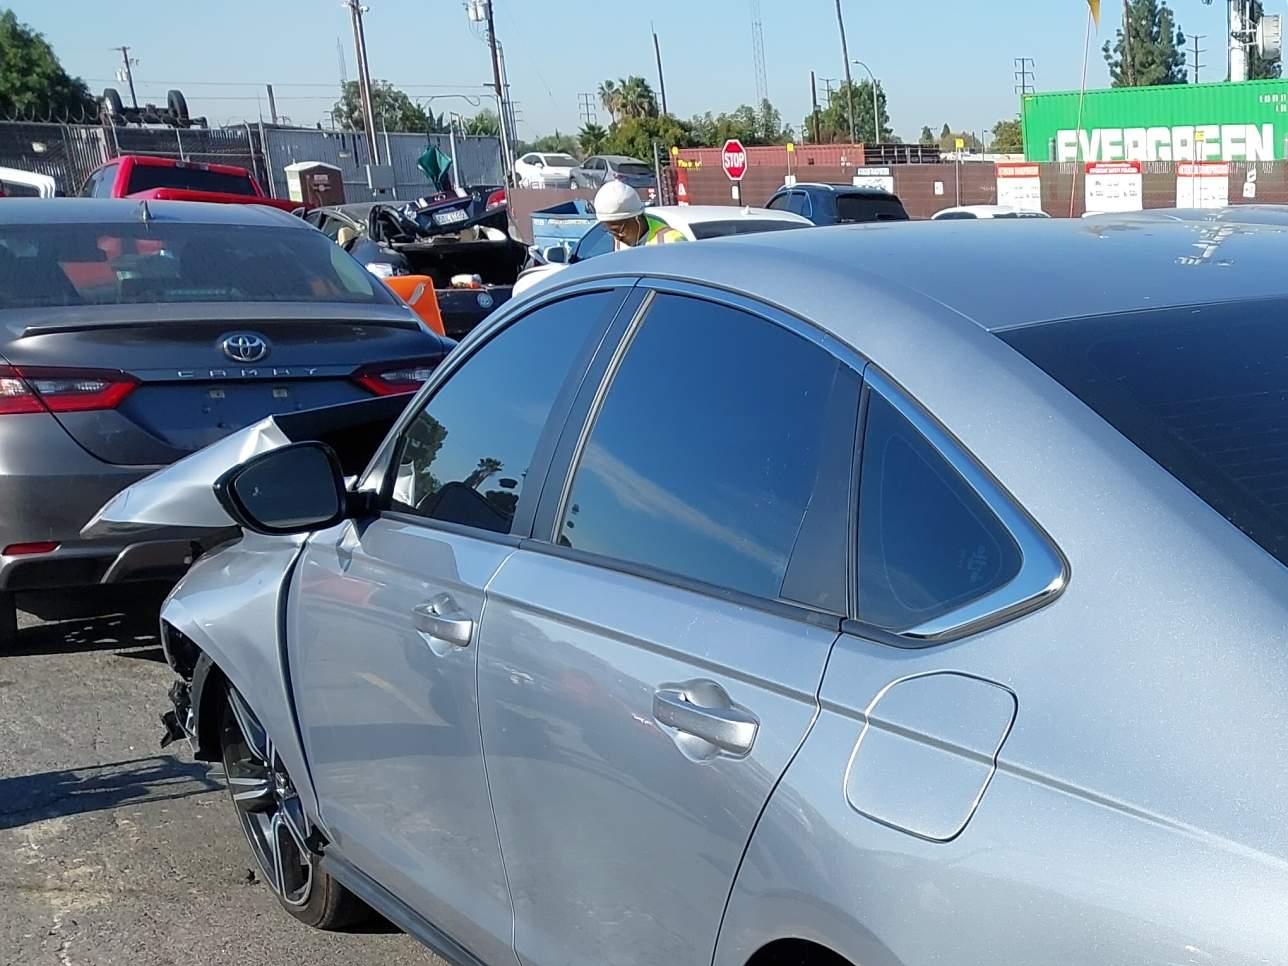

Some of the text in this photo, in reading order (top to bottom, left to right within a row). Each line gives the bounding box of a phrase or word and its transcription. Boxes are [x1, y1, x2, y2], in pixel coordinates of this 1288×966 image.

[1056, 123, 1274, 161] EVERGREEN
[724, 154, 745, 169] STOP
[177, 368, 317, 378] CAMRY
